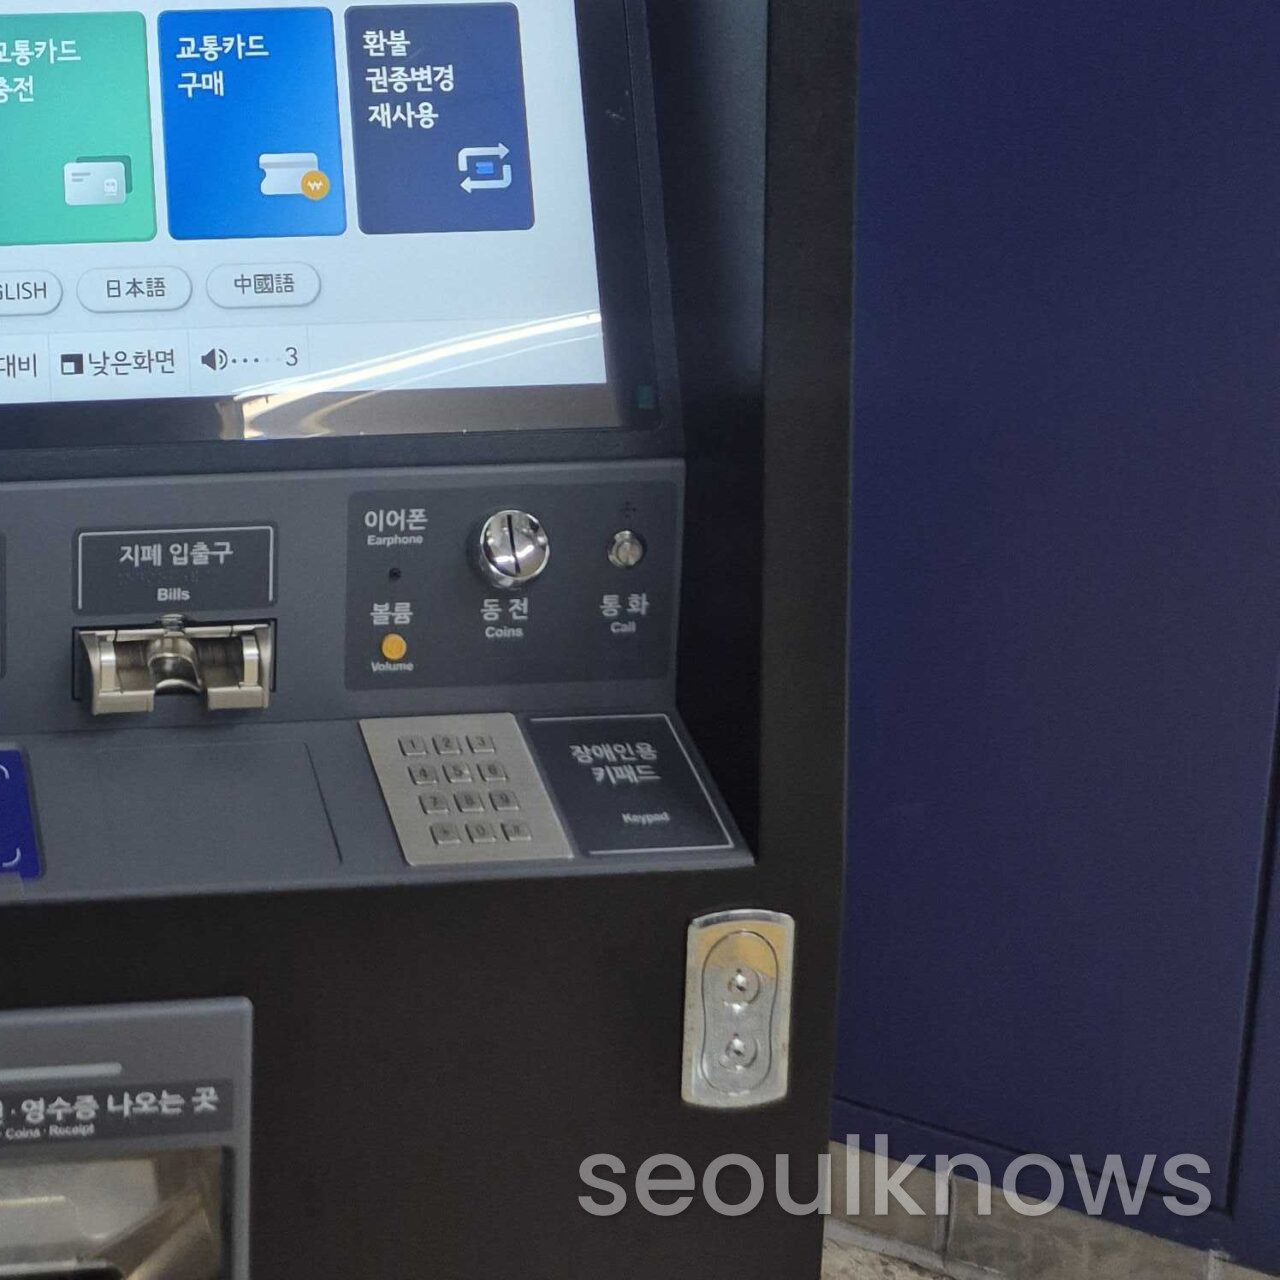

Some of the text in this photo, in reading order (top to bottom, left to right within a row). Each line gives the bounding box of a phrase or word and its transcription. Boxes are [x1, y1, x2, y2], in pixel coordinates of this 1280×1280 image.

[176, 33, 270, 61] 교통카드
[363, 29, 411, 57] 환불
[178, 70, 224, 99] 구매
[365, 64, 455, 94] 권종변경
[368, 101, 439, 131] 재사용
[106, 276, 167, 299] 日本語
[233, 272, 296, 295] 中國語
[88, 349, 176, 378] 낮은화면
[285, 346, 299, 368] 3
[364, 508, 428, 532] 이어폰
[367, 533, 424, 547] Earphone
[120, 540, 234, 568] 지폐 입출구
[157, 587, 191, 602] Bills
[370, 602, 414, 625] 볼륨
[485, 625, 523, 639] Coins
[610, 621, 636, 634] Call
[371, 661, 414, 672] Volume
[569, 742, 659, 764] 장애인용
[591, 765, 662, 785] 키패드
[622, 811, 670, 825] Keypad
[21, 1094, 100, 1124] 영수증
[107, 1089, 185, 1118] 나오는
[192, 1085, 218, 1114] 곳
[5, 1127, 41, 1140] Coins
